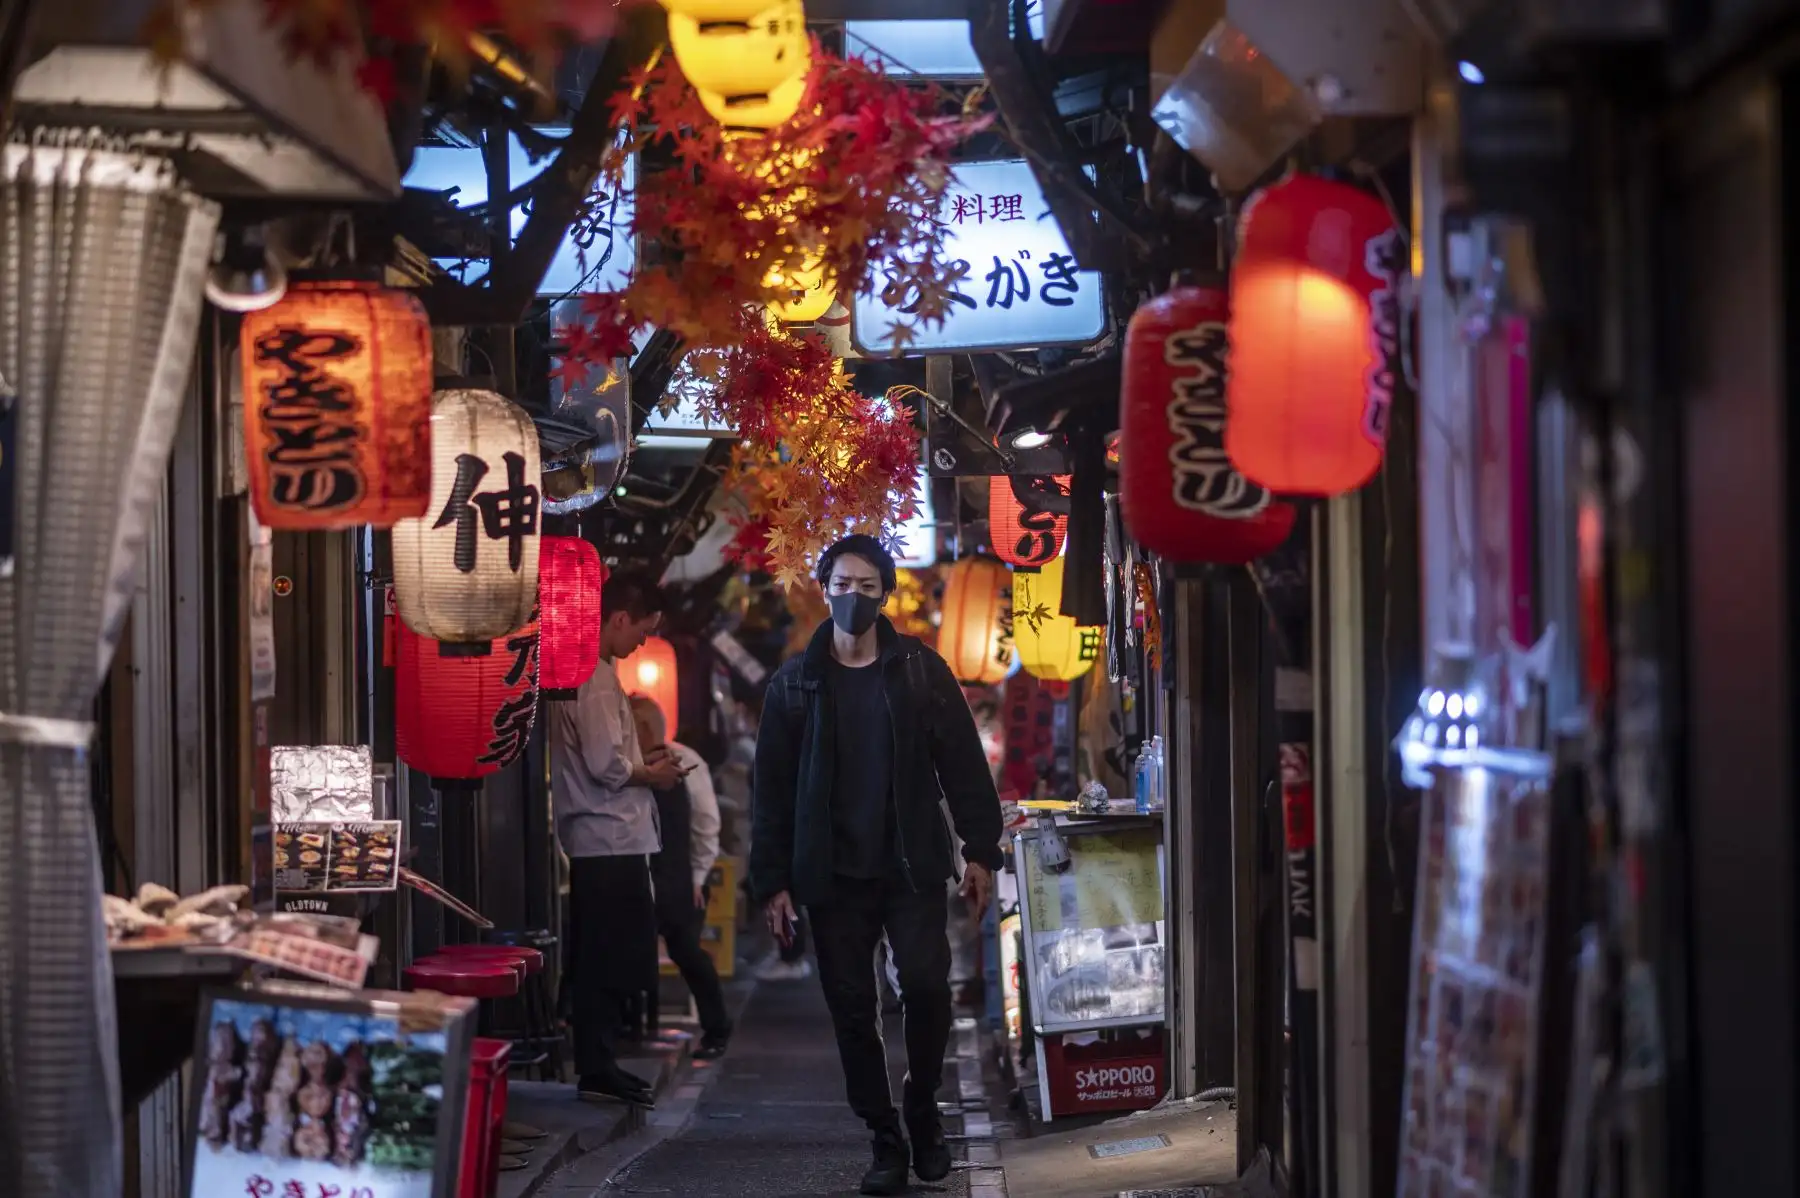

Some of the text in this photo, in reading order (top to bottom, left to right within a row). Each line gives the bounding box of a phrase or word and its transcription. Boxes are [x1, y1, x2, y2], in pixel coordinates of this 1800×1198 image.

[254, 325, 366, 511] やきとり
[432, 450, 540, 573] 伸
